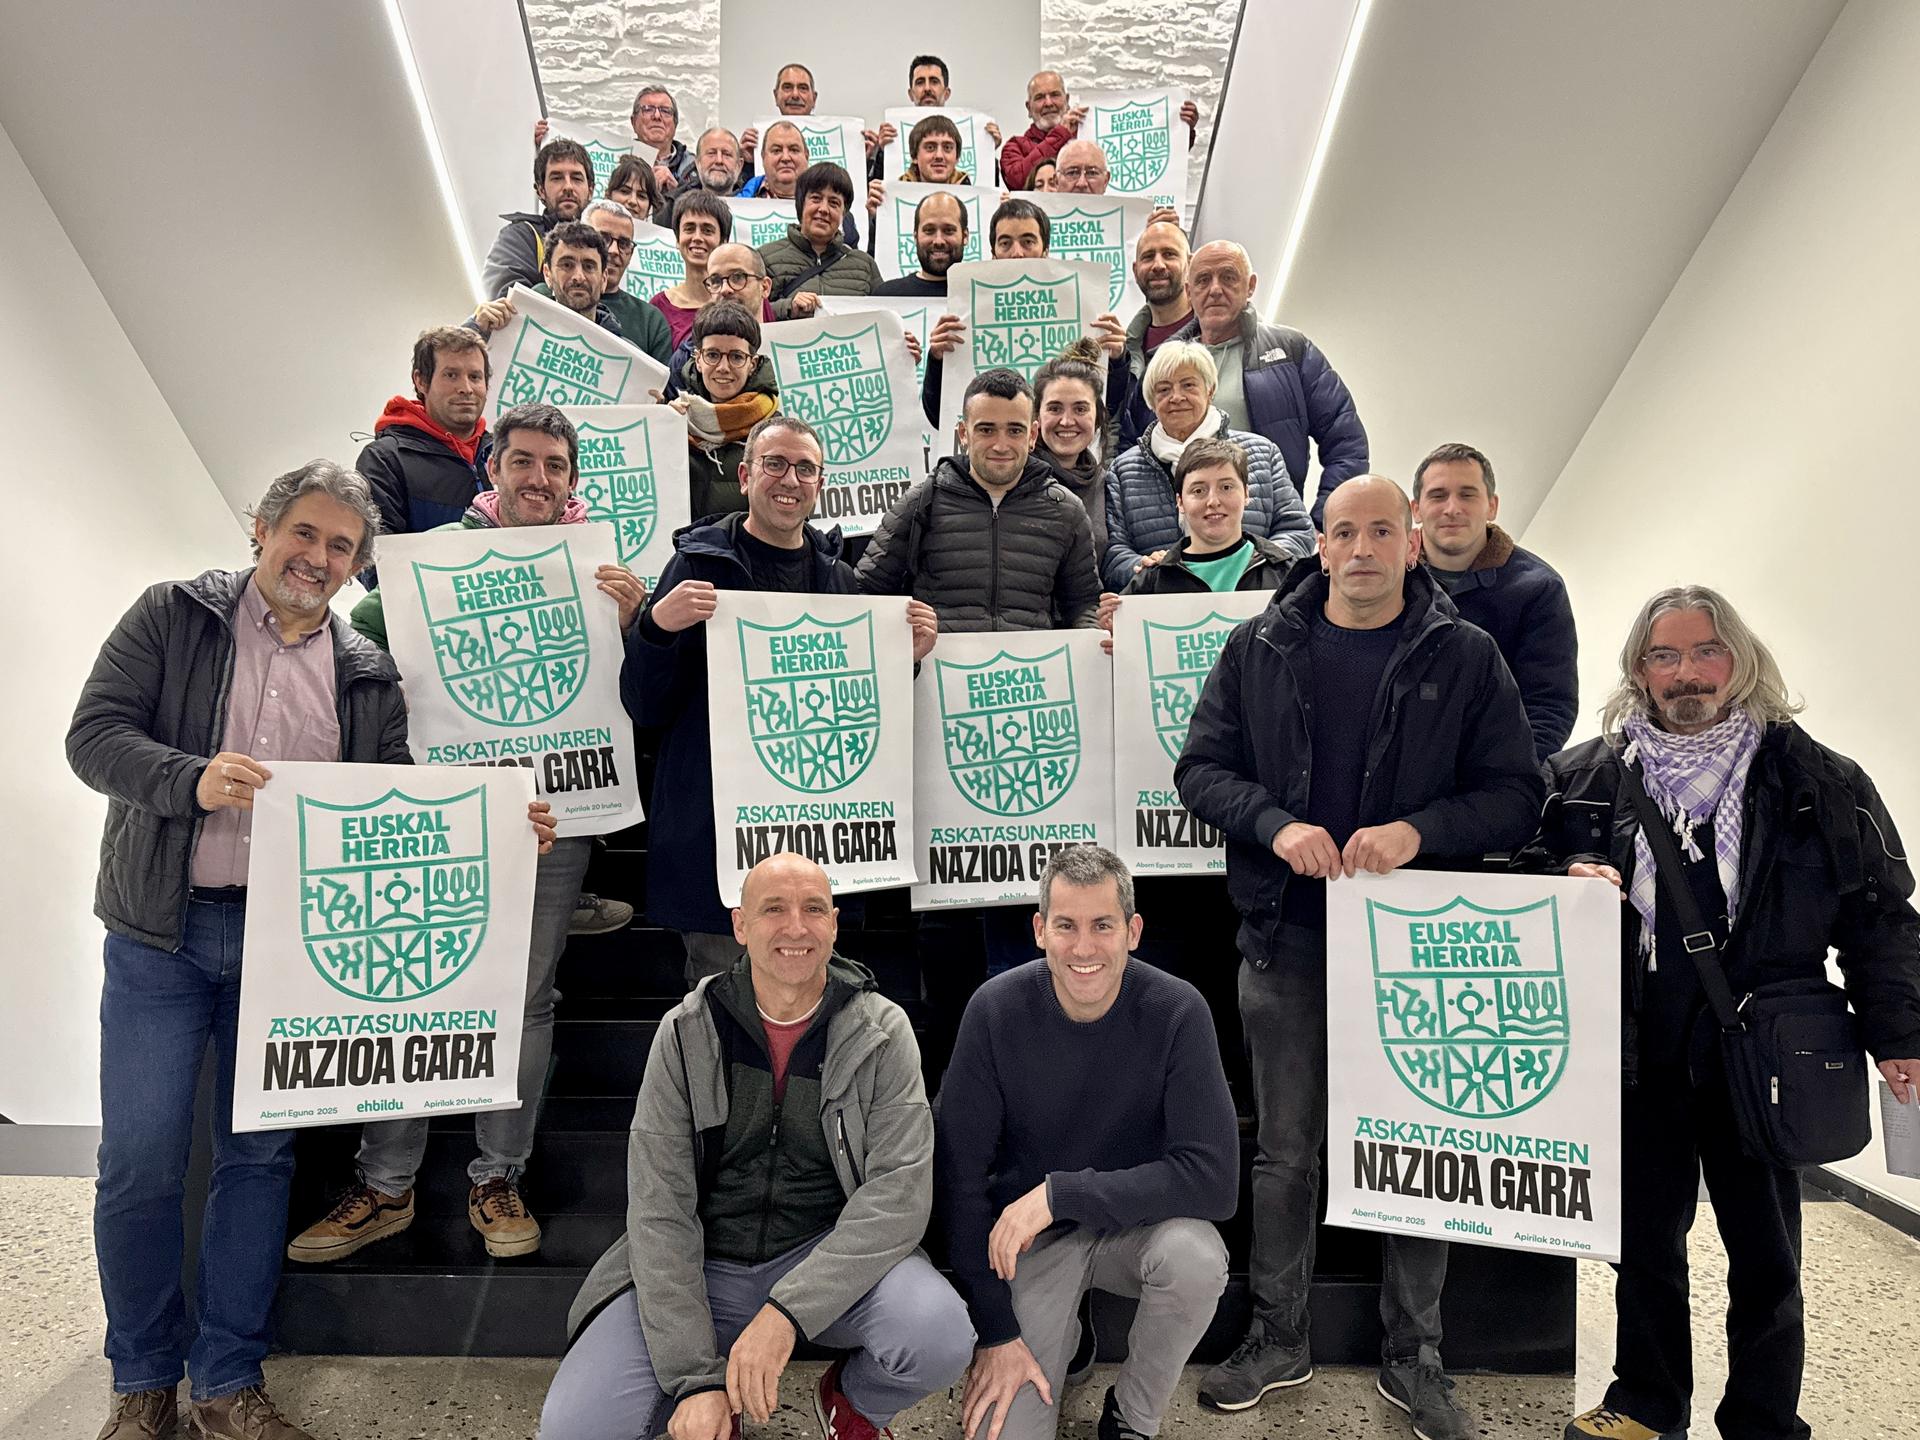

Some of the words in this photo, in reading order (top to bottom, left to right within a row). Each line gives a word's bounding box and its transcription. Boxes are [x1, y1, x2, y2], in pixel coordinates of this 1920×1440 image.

[1111, 108, 1153, 123] EUSKAL
[1111, 118, 1153, 133] HERRIA
[807, 136, 829, 146] KAL
[811, 146, 830, 157] RIA
[589, 151, 616, 163] SKAL
[751, 222, 788, 235] EUSK
[1050, 220, 1104, 235] EUSKAL
[1050, 233, 1104, 247] HERRIA
[637, 248, 684, 263] EUSKAL
[640, 260, 685, 275] HERRIA
[994, 288, 1058, 306] EUSKAL
[994, 304, 1058, 321] HERRIA
[541, 338, 604, 375] EUSKAL
[797, 342, 860, 365] EUSKAL
[536, 352, 599, 388] HERRIA
[800, 356, 862, 380] HERRIA
[578, 436, 625, 454] SKAL
[579, 452, 627, 470] RRIA
[452, 564, 544, 593] EUSKAL
[456, 582, 547, 612] HERRIA
[769, 631, 848, 655] EUSKAL
[1176, 630, 1230, 652] EUSK
[771, 650, 849, 675] HERRIA
[1178, 650, 1221, 670] HER
[967, 665, 1046, 692] EUSKAL
[968, 684, 1047, 709] HERRIA
[427, 727, 612, 763] ASKATASUNAREN
[543, 746, 620, 794] GARA
[736, 801, 894, 824] ASKATASUNAREN
[341, 810, 451, 840] EUSKAL
[930, 823, 1096, 844] ASKATASUNAREN
[342, 834, 451, 863] HERRIA
[832, 820, 898, 864] GARA
[929, 844, 1025, 885] NAZIOA
[1408, 921, 1520, 945] EUSKAL
[1411, 945, 1522, 968] HERRIA
[268, 1009, 497, 1039] ASKATASUNAREN
[262, 1037, 396, 1091] NAZIOA
[402, 1032, 497, 1083] GARA
[260, 1109, 287, 1119] Aberri
[288, 1109, 314, 1119] Eguna
[317, 1107, 338, 1115] 2025
[356, 1098, 404, 1112] ehbildu
[424, 1099, 455, 1109] Apirilak
[1354, 1116, 1589, 1165] ASKATASUNAREN
[1354, 1140, 1482, 1206] NAZIOA
[1490, 1156, 1594, 1222] GARA
[1352, 1208, 1376, 1218] Aberri
[1377, 1211, 1403, 1222] Eguna
[1405, 1216, 1426, 1225] 2025
[1444, 1218, 1493, 1236] ehbildu
[1514, 1232, 1548, 1244] Apirilak
[1549, 1237, 1561, 1246] 20
[1562, 1239, 1592, 1250] Iruñea
